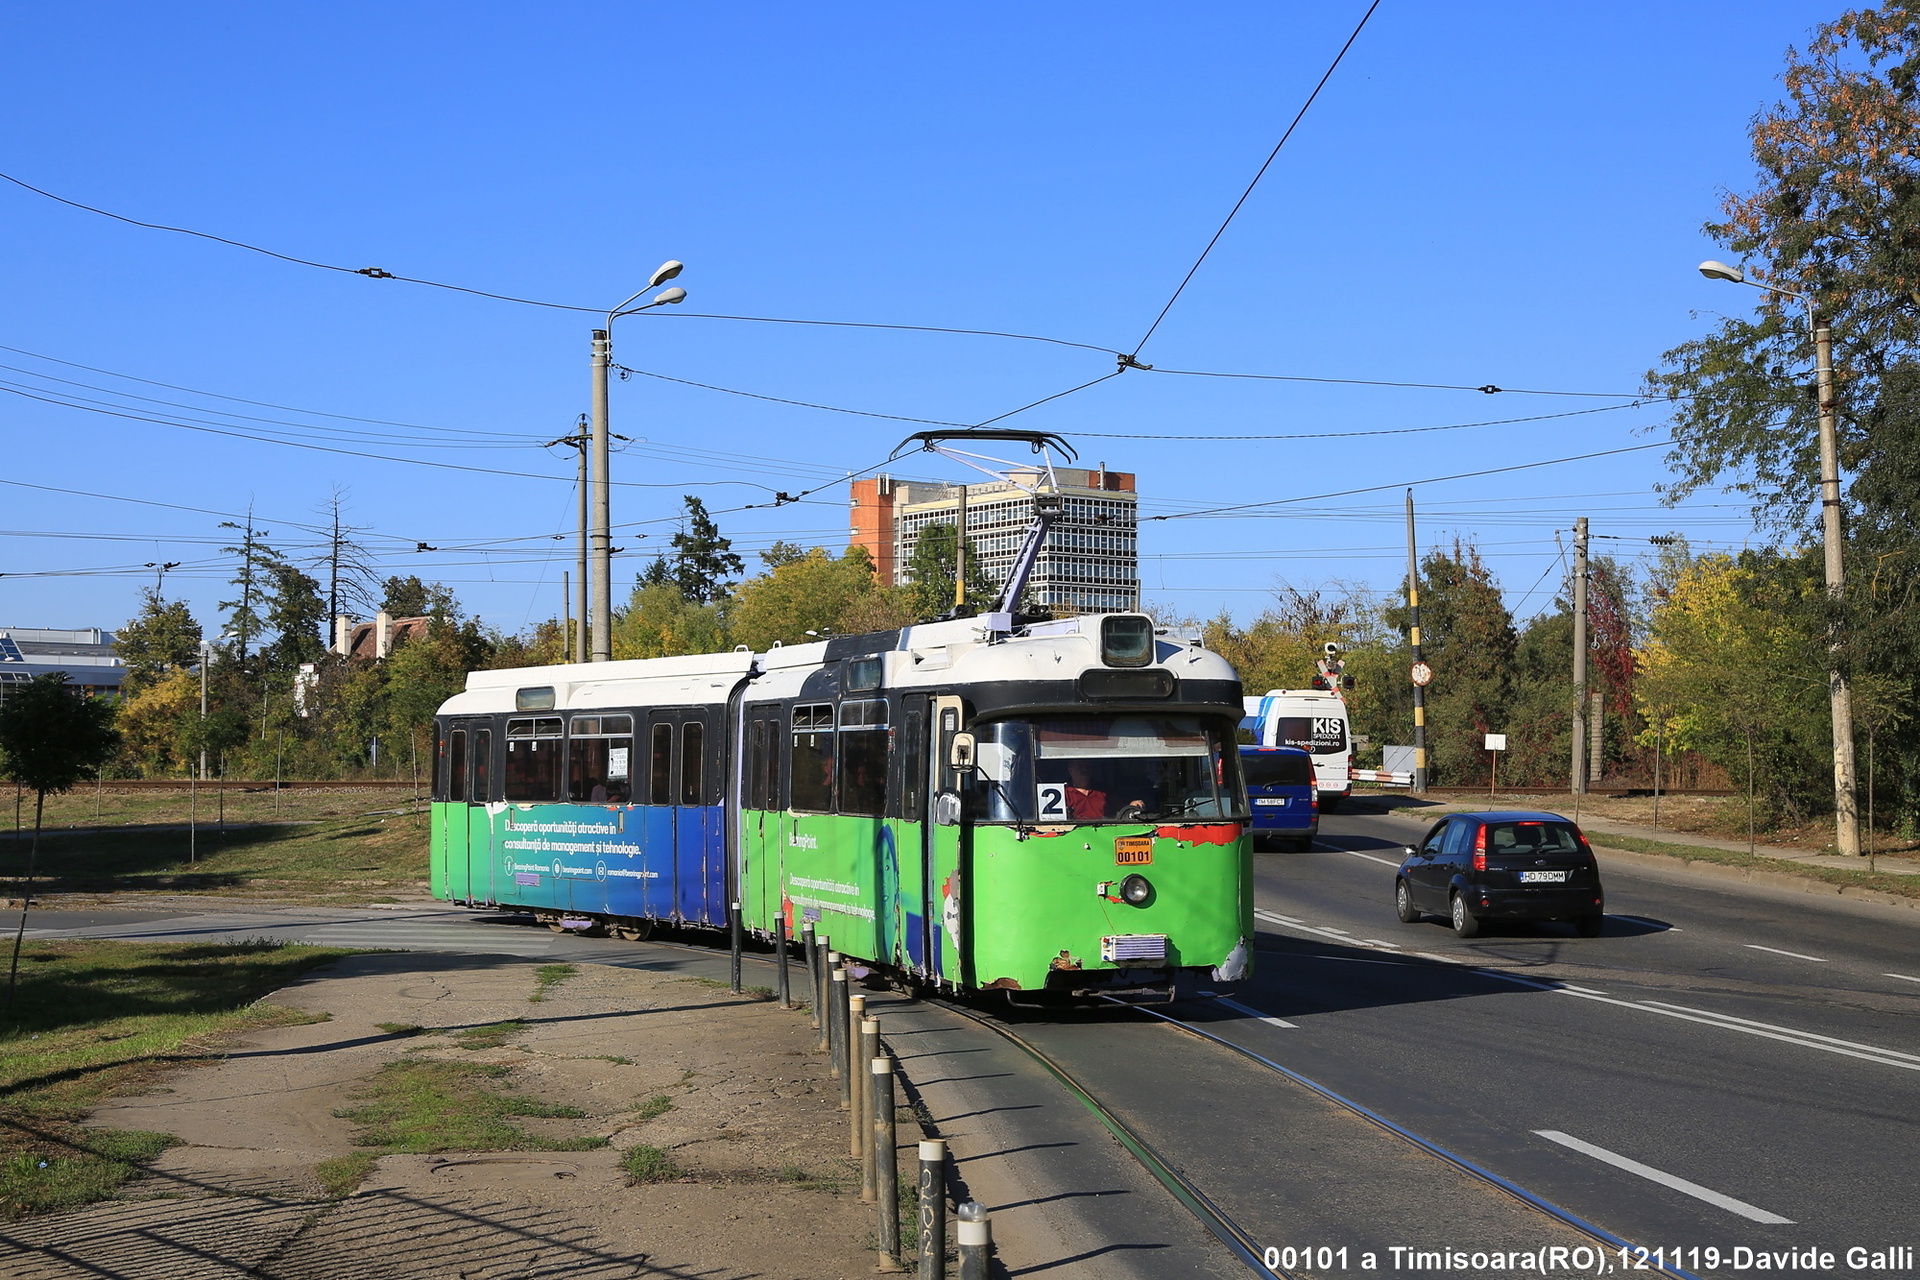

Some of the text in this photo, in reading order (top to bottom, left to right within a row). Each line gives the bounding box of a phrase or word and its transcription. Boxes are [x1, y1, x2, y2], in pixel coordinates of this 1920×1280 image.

[1313, 718, 1341, 734] KIS
[1284, 738, 1340, 747] kis-spedizioni.ro
[1041, 788, 1064, 815] 2
[577, 821, 609, 835] atractive
[609, 822, 617, 835] în
[542, 840, 551, 851] de
[551, 841, 595, 855] management
[602, 841, 642, 858] tehnologie.
[1118, 851, 1149, 863] 00101
[562, 866, 593, 876] bearingpoint.com
[1525, 872, 1564, 880] HD 79DMM
